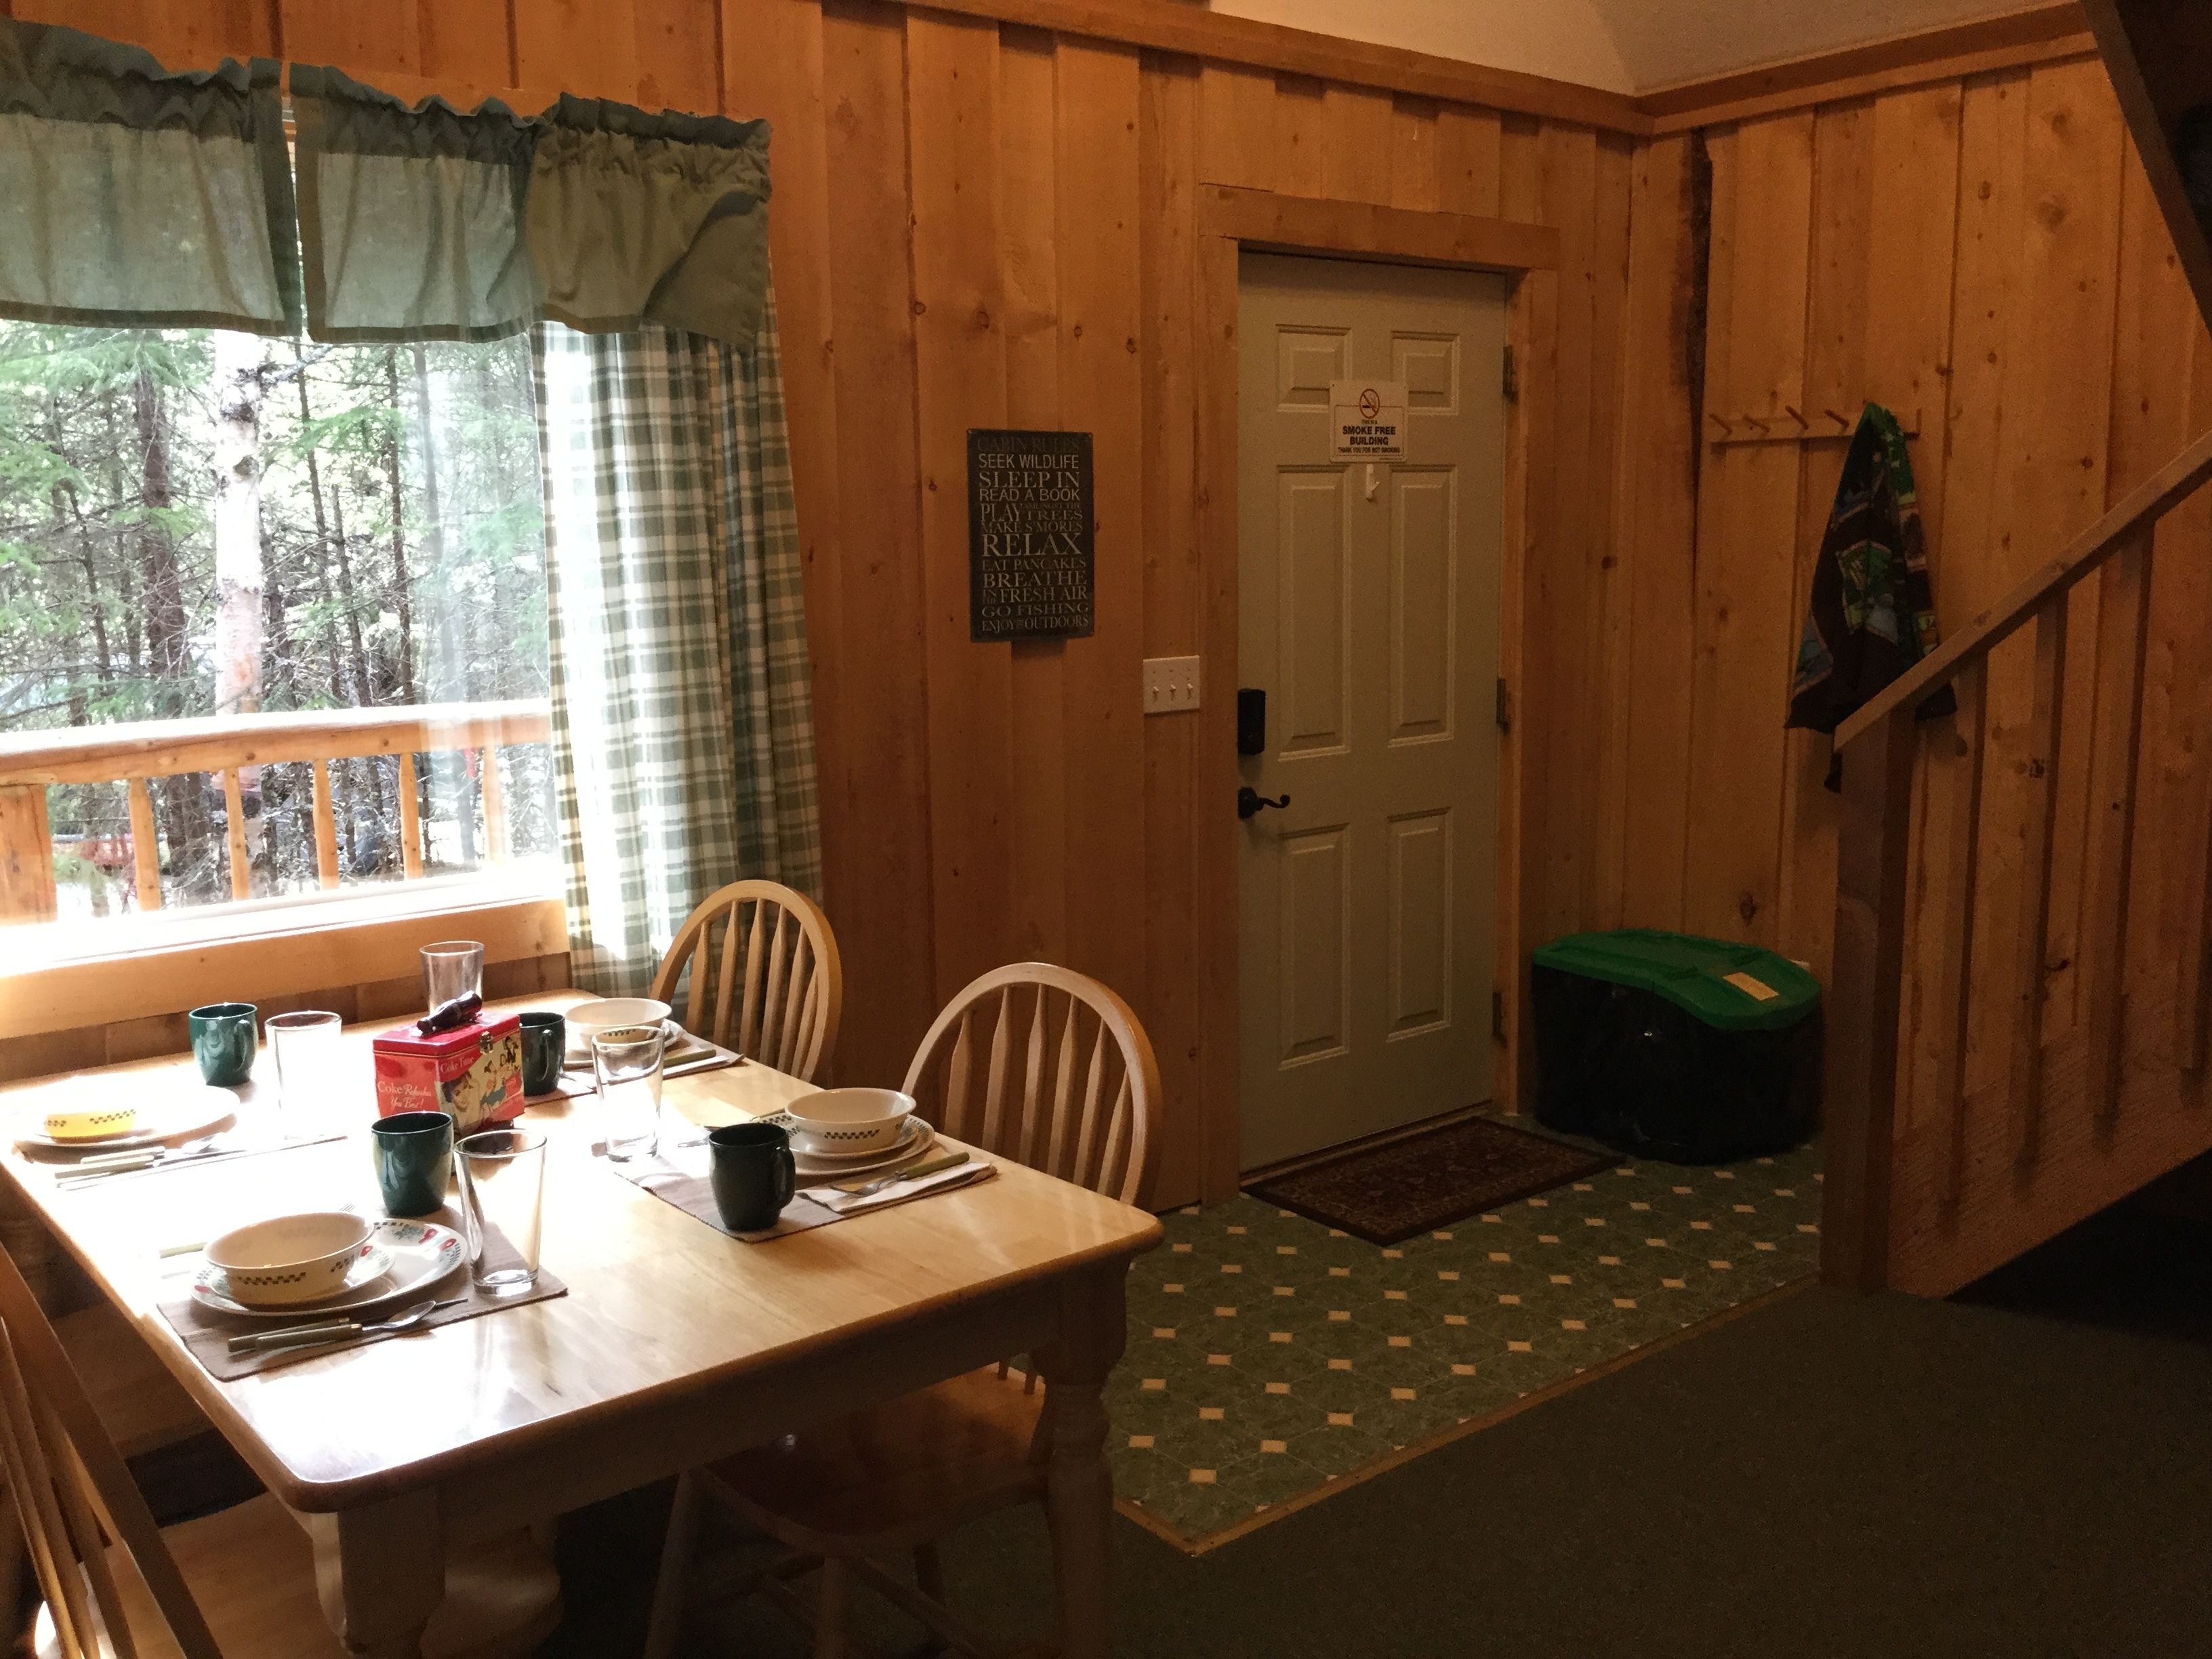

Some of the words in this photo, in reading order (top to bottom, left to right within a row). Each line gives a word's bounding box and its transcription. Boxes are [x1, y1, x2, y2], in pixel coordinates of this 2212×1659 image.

[1343, 426, 1372, 434] SMOKE
[1375, 426, 1396, 434] FREE
[977, 436, 1027, 452] CABIN
[1032, 437, 1080, 453] RULES
[1350, 436, 1389, 445] BUILDING
[979, 453, 1015, 469] SEEK
[1019, 454, 1080, 469] WILDLIFE
[979, 471, 1050, 489] SLEEP
[1057, 472, 1080, 488] IN
[979, 488, 1019, 501] READ
[1025, 489, 1035, 501] A
[1040, 488, 1080, 501] BOOK
[981, 503, 1022, 522] PLAY
[1025, 510, 1083, 520] TREES
[981, 521, 1022, 533] MAKE
[1025, 521, 1084, 532] S'MORES
[982, 532, 1082, 557] RELAX
[983, 559, 1008, 571] EAT
[1014, 558, 1086, 570] PANCAKES
[983, 571, 1088, 588] BREATHE
[983, 589, 998, 598] IN
[1000, 587, 1055, 603] FRESH
[1061, 586, 1088, 600] AIR
[982, 606, 1011, 617] GO
[1018, 602, 1088, 616] FISHING
[982, 619, 1015, 634] ENJOY
[1024, 615, 1089, 629] OUTDOORS
[440, 1063, 459, 1073] Coke
[377, 1080, 403, 1094] Coke
[390, 1095, 403, 1110] You
